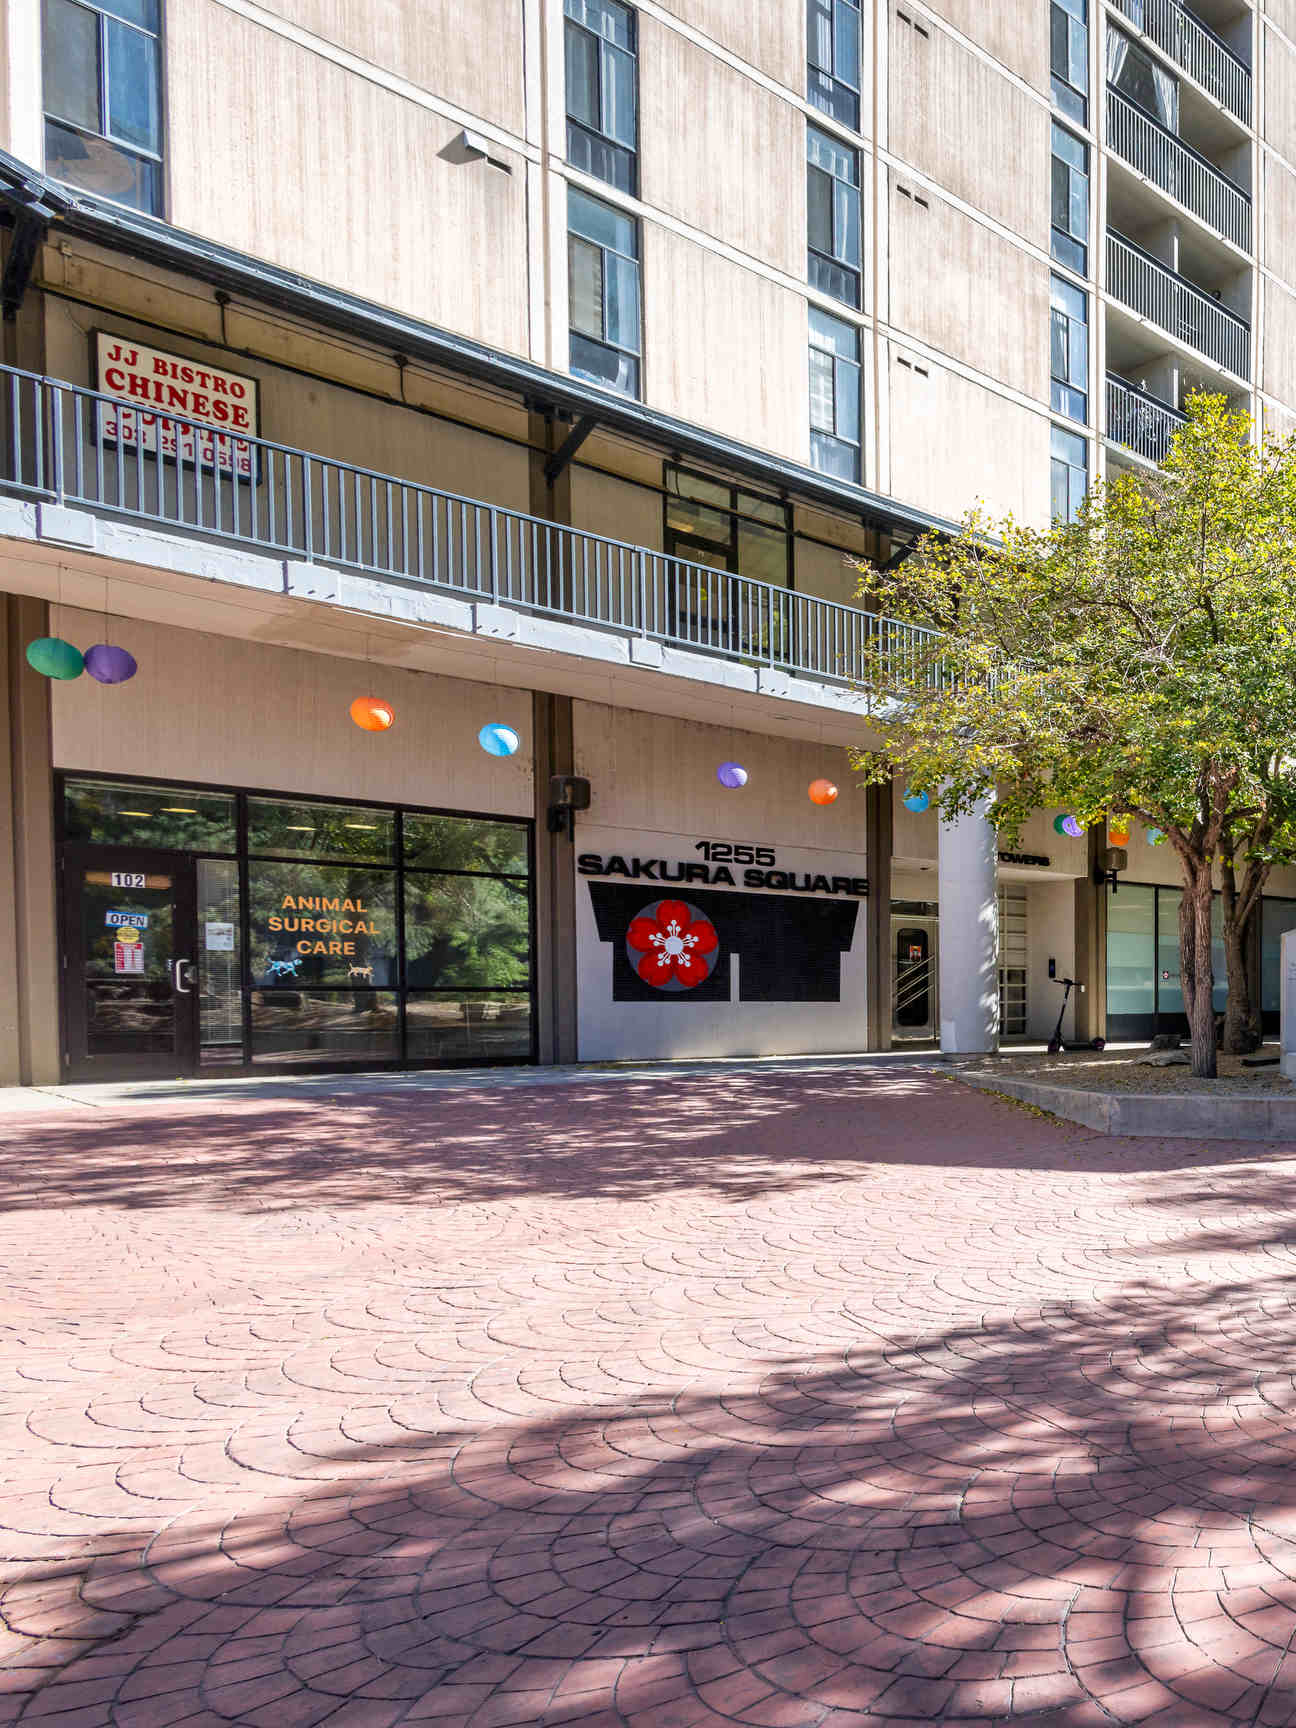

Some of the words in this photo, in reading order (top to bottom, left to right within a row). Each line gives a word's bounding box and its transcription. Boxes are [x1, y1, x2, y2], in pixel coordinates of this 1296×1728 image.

[107, 344, 139, 366] JJ
[152, 357, 246, 399] BISTRO
[105, 367, 250, 429] CHINESE
[105, 420, 147, 444] 30
[695, 840, 776, 867] 1255
[114, 873, 144, 888] 102
[577, 853, 736, 887] SAKURA
[743, 868, 871, 897] SQUARE
[281, 895, 369, 913] ANIMAL
[110, 913, 145, 929] OPEN
[268, 916, 381, 935] SURGICAL
[296, 940, 356, 955] CARE
